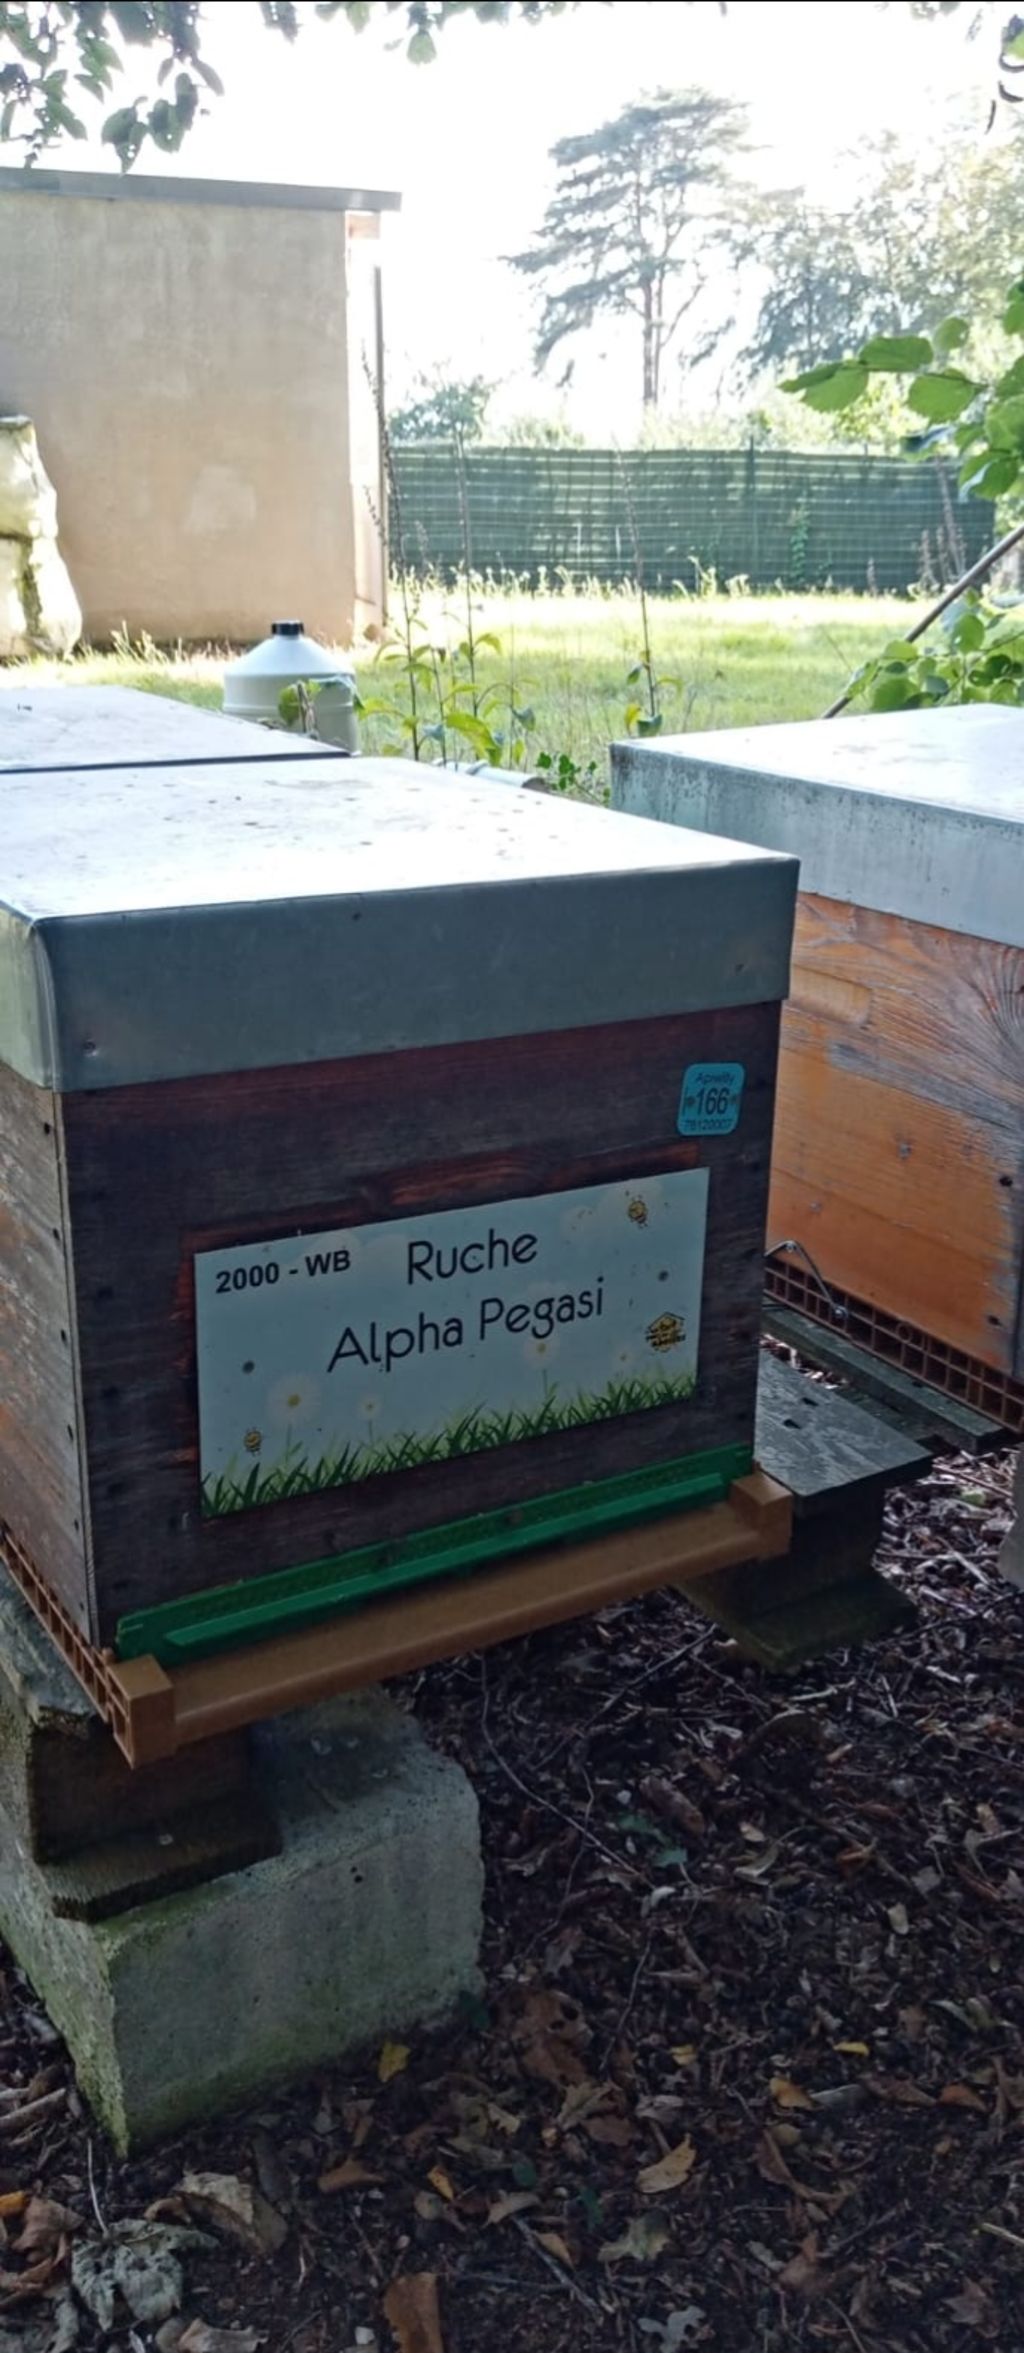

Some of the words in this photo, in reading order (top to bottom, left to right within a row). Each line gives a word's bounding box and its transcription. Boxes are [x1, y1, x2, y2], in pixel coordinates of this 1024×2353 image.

[696, 1087, 730, 1116] 166
[215, 1262, 280, 1294] 2000
[305, 1249, 352, 1277] WB
[407, 1227, 539, 1285] Ruche
[326, 1311, 463, 1373] Alpha
[479, 1275, 605, 1341] Pegasi
